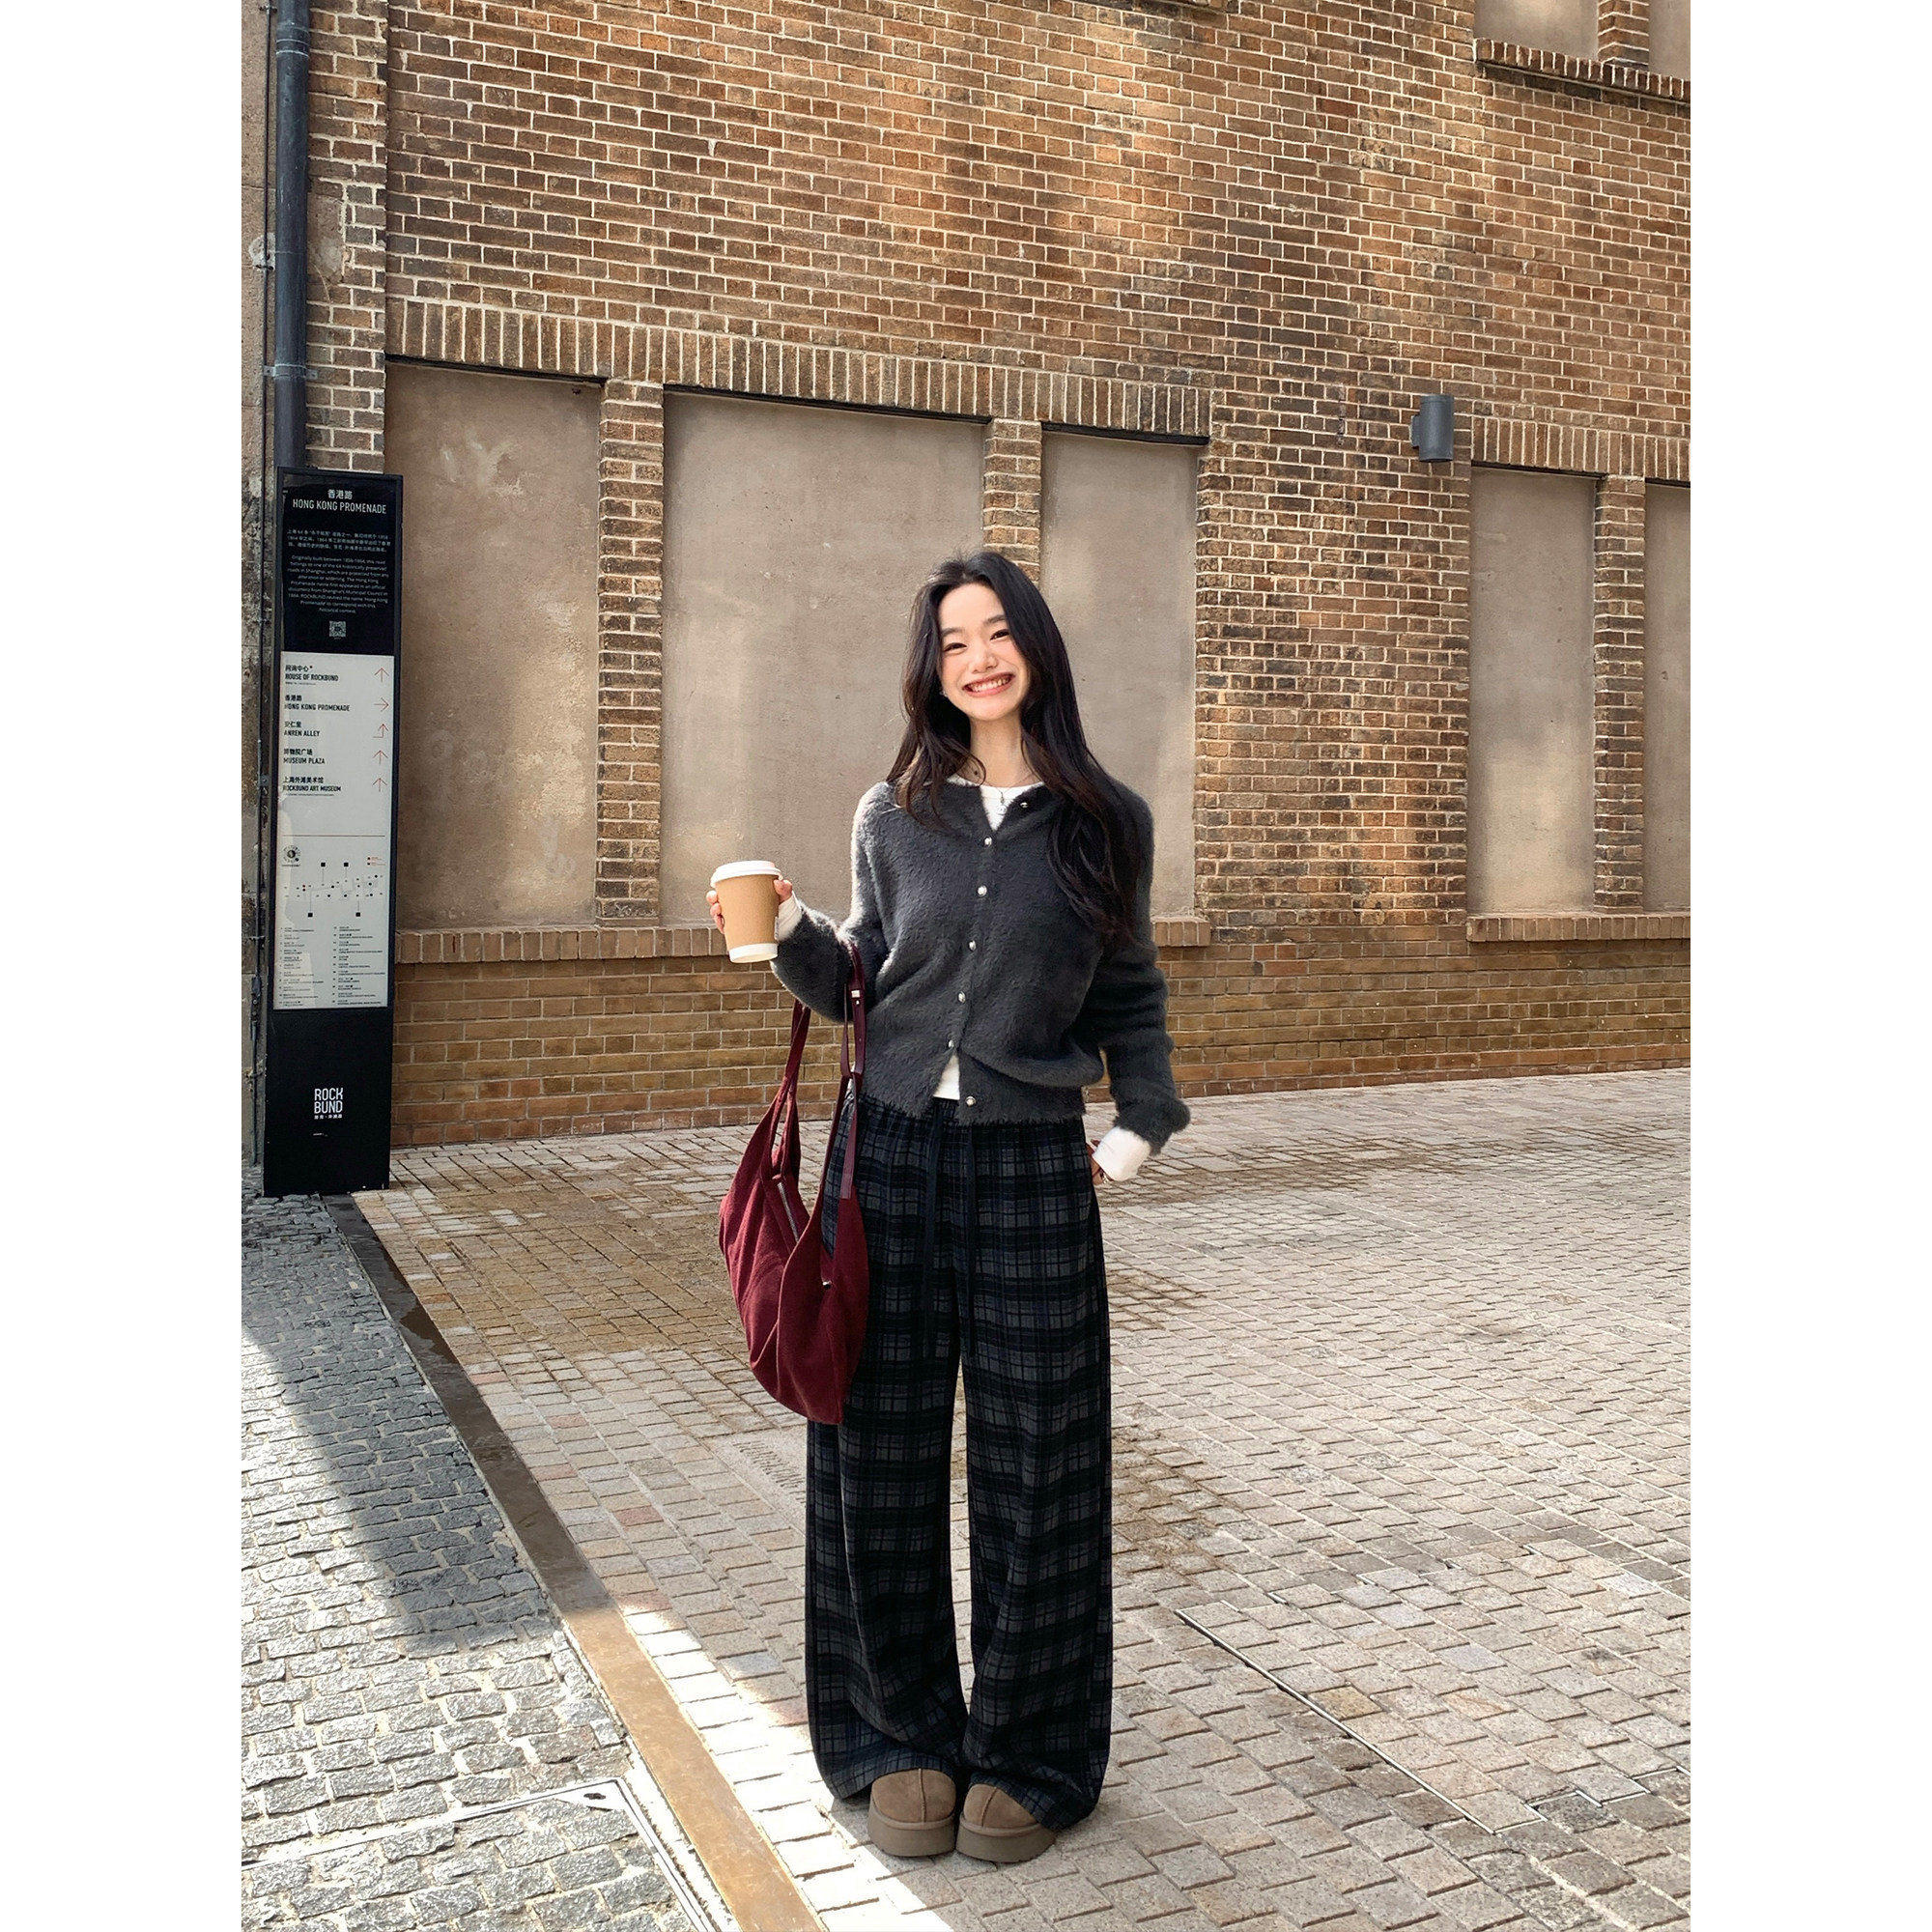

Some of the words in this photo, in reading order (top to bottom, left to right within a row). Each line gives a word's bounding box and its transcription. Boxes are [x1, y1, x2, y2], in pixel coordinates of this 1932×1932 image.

[327, 489, 353, 500] 香港路
[293, 498, 315, 509] HONG
[316, 500, 338, 511] KONG
[339, 501, 386, 514] PROMENADE
[314, 1088, 344, 1101] ROCK
[314, 1100, 343, 1114] BUND
